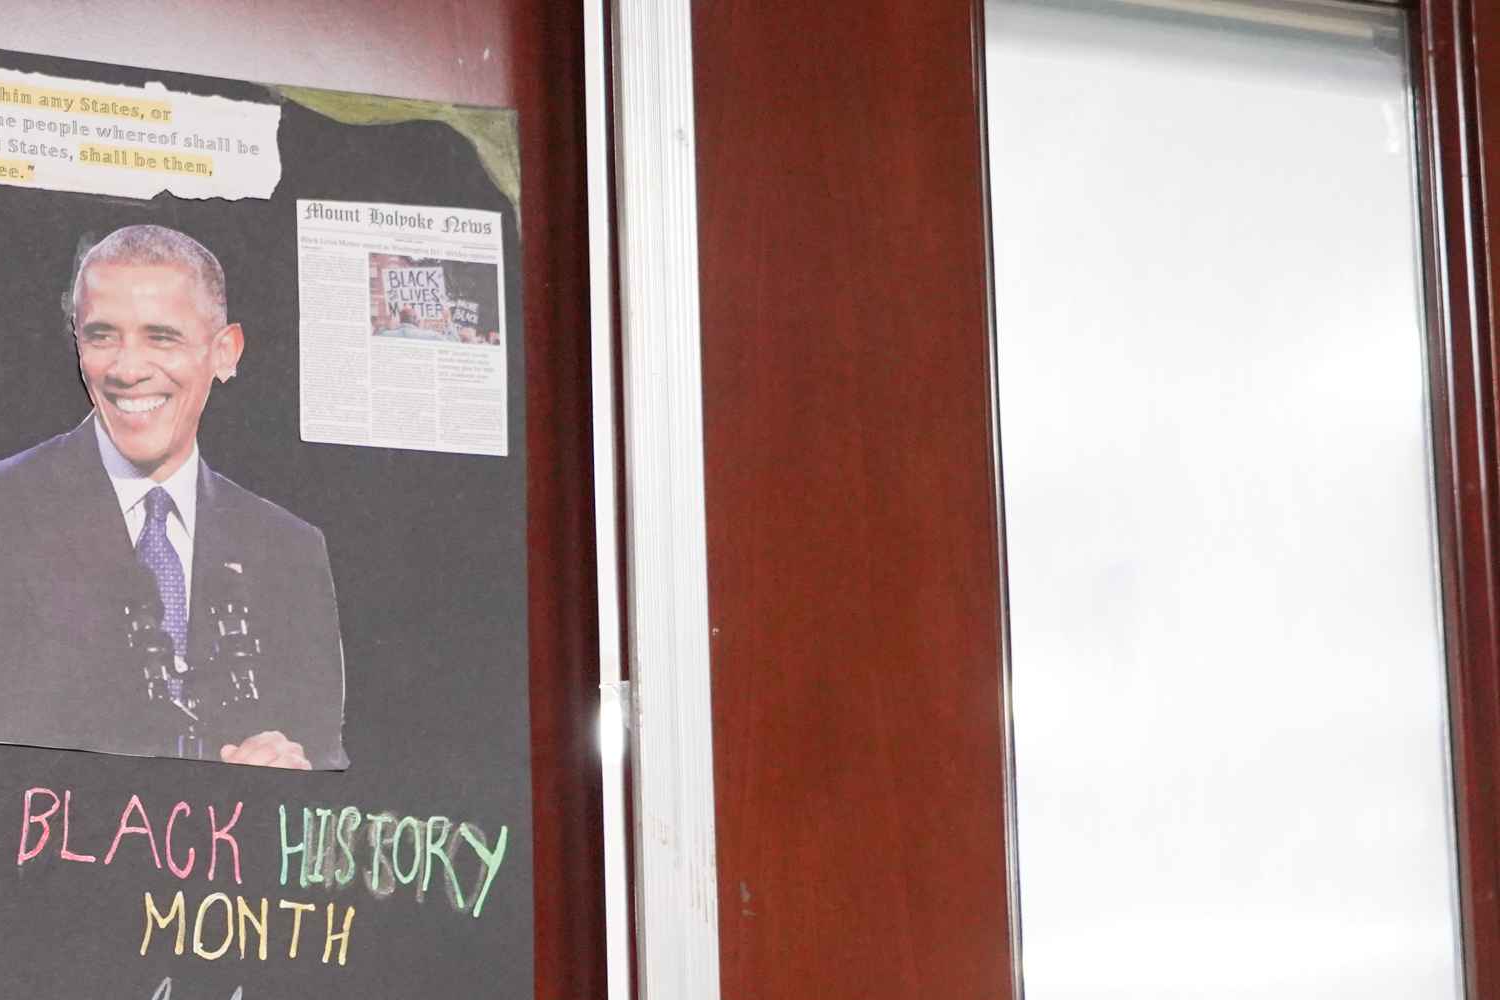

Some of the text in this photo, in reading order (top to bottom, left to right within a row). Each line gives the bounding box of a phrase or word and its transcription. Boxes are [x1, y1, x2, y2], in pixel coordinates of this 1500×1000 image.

[38, 95, 74, 112] any
[80, 97, 146, 120] States,
[151, 107, 171, 121] or
[23, 116, 90, 137] people
[96, 124, 179, 147] whereof
[183, 134, 230, 154] shall
[237, 139, 260, 156] be
[8, 137, 74, 161] States,
[79, 146, 127, 167] shall
[134, 151, 157, 168] be
[162, 155, 213, 177] then,
[303, 203, 493, 235] Mount Holyoke News
[388, 270, 441, 288] BLACK
[399, 289, 441, 302] LIVES
[16, 787, 509, 918] BLACK HISTORY
[140, 890, 355, 966] MONTH
